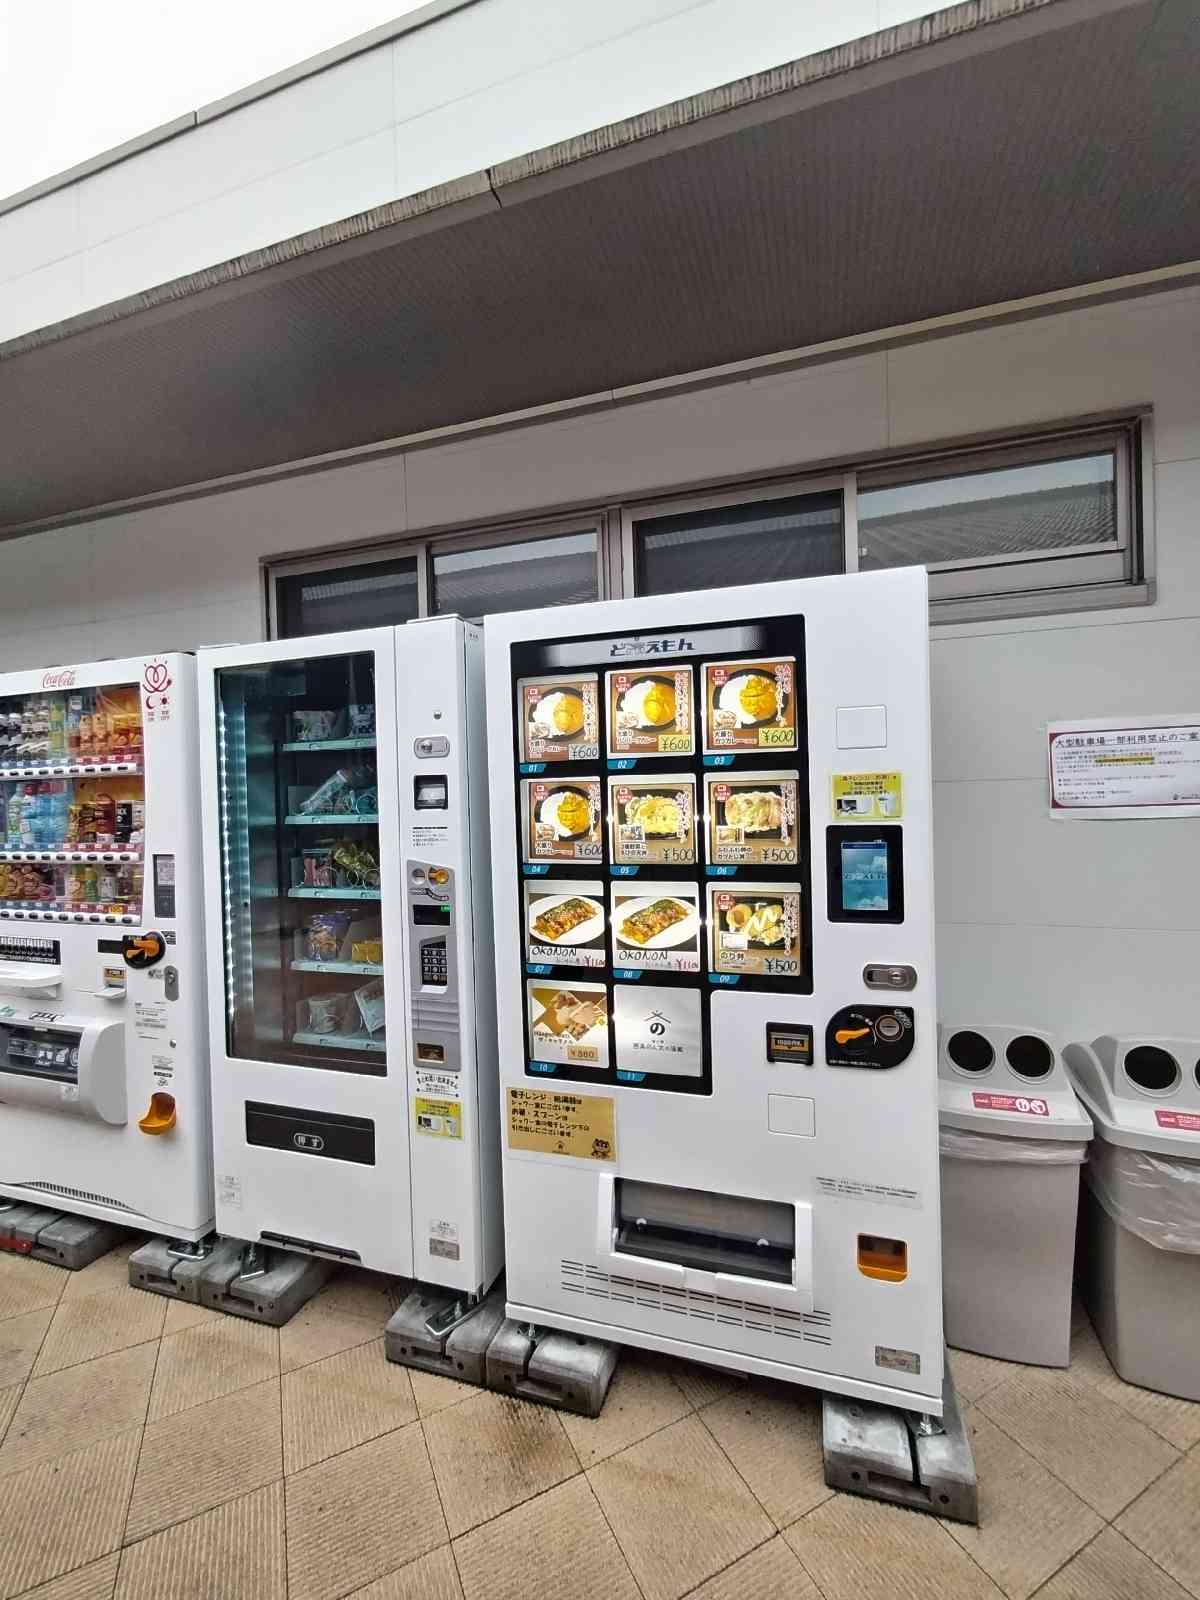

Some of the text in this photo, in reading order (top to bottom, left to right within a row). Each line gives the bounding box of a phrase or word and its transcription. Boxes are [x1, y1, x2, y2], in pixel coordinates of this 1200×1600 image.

[762, 730, 793, 744] ¥600
[661, 737, 690, 751] ¥600
[570, 746, 598, 758] ¥600
[617, 760, 628, 769] 02
[714, 756, 725, 765] 03
[528, 764, 538, 773] 01
[663, 848, 694, 862] ¥500
[761, 848, 795, 862] ¥500
[620, 866, 630, 875] 05
[717, 866, 728, 875] 06
[764, 958, 798, 973] ¥500
[719, 974, 730, 984] 09
[626, 1072, 636, 1081] 11
